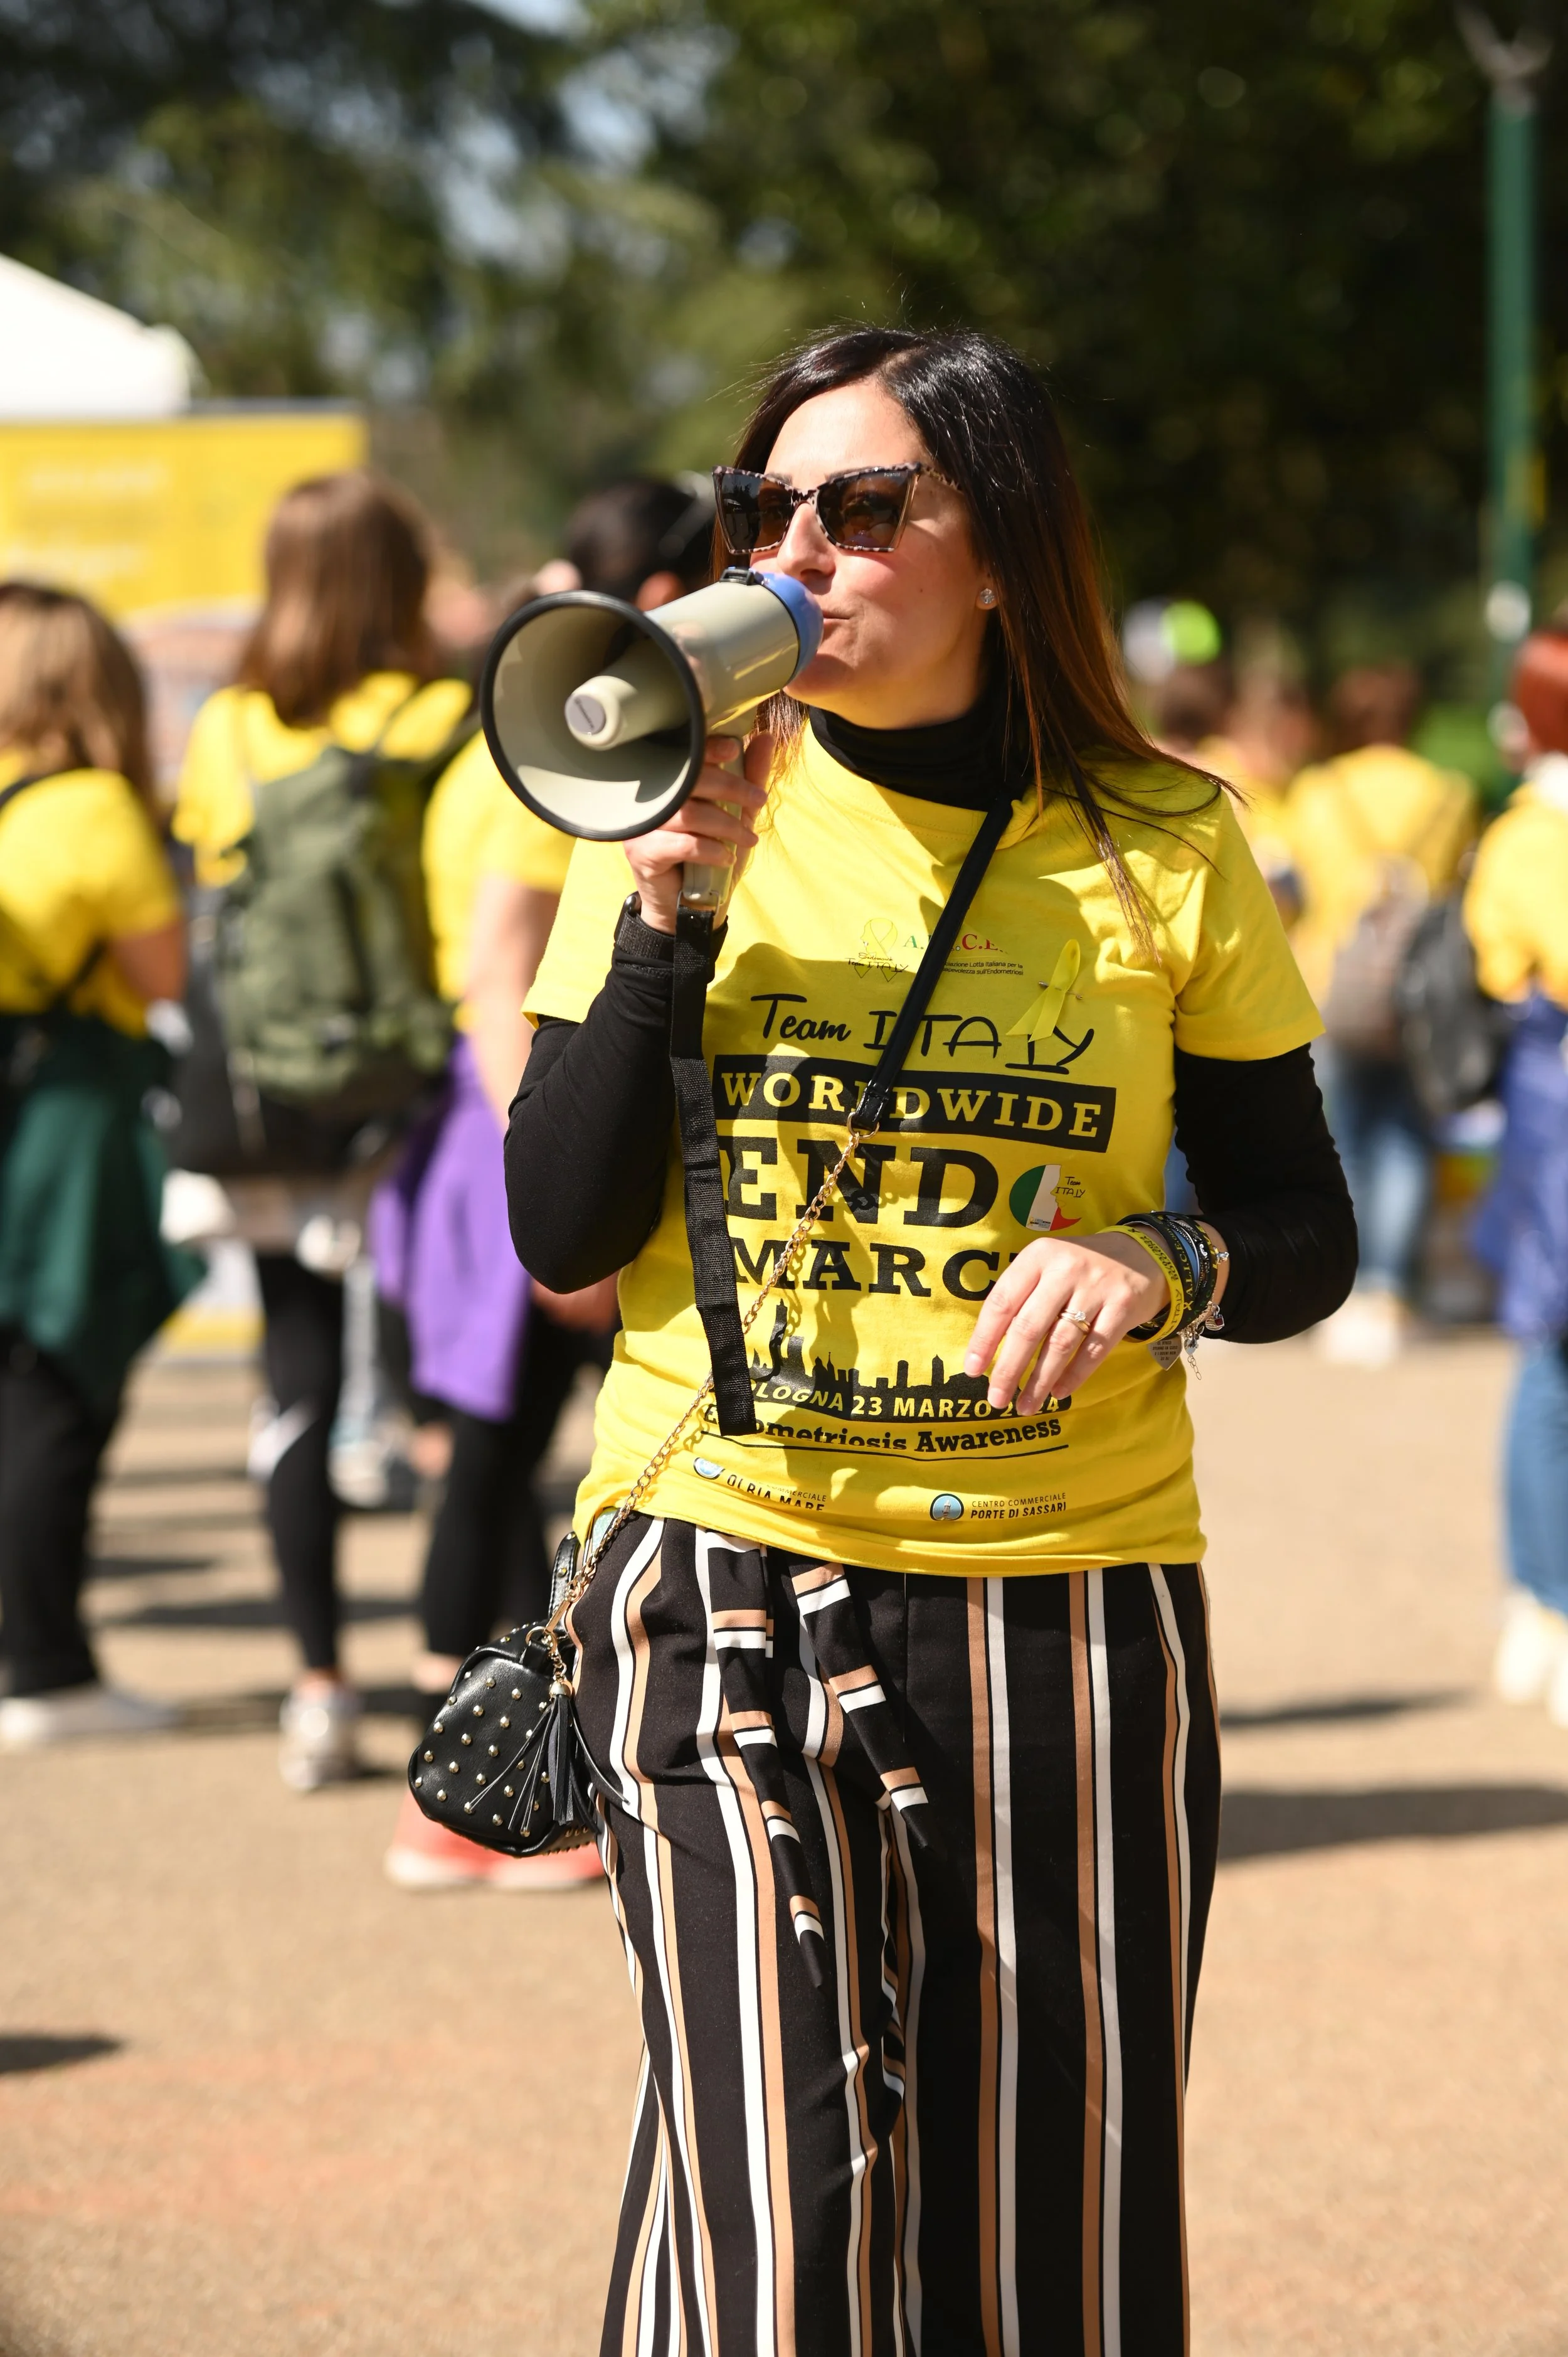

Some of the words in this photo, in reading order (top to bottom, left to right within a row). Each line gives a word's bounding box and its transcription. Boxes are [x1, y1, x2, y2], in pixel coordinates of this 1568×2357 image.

[867, 962, 909, 972] ITALY
[750, 994, 851, 1041] Team
[863, 1010, 1094, 1075] ITALY
[1064, 1176, 1081, 1185] Team
[1055, 1187, 1086, 1198] ITALY
[730, 1236, 1018, 1301] MARC
[751, 1380, 844, 1412] LOGNA
[851, 1396, 883, 1416] 23
[893, 1398, 991, 1418] MARZO
[914, 1418, 1062, 1452] Awareness
[1008, 1492, 1066, 1506] COMMERCIALE
[971, 1509, 1004, 1519] PORTE
[1009, 1509, 1019, 1518] DI
[1022, 1501, 1066, 1517] SASSARI
